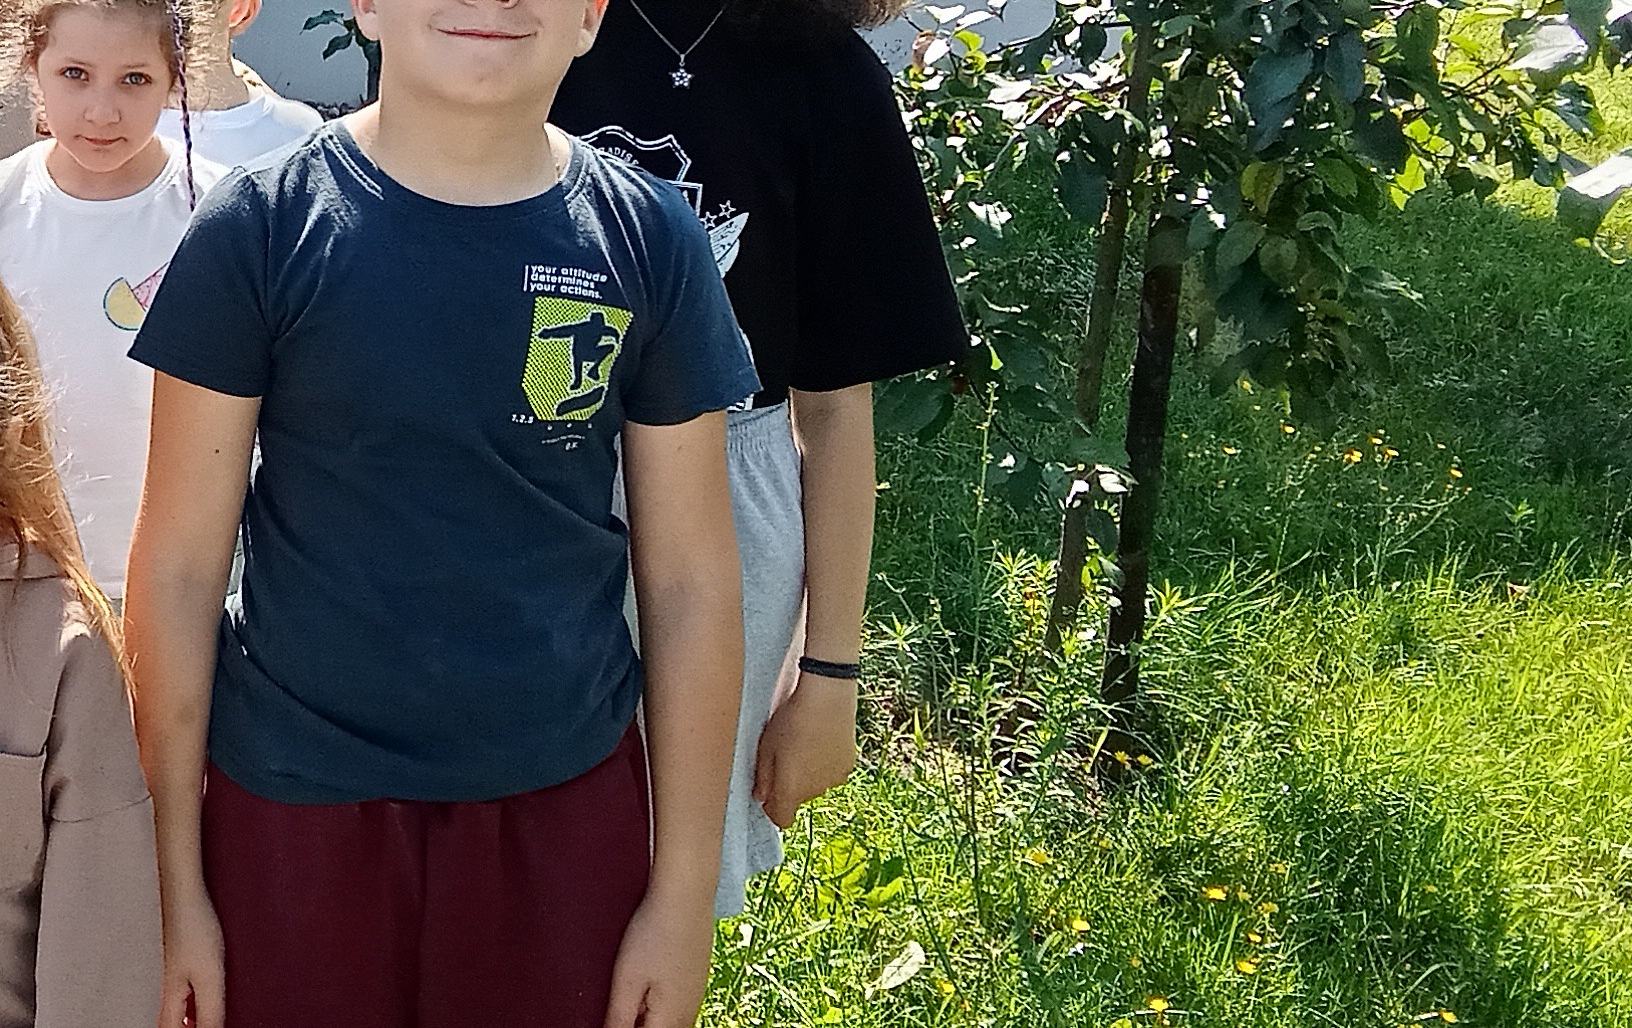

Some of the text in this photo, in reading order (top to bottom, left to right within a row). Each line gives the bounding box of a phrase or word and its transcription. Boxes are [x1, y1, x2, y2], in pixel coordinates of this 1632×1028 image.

[531, 264, 557, 275] your
[530, 272, 595, 288] determines
[530, 282, 556, 292] your
